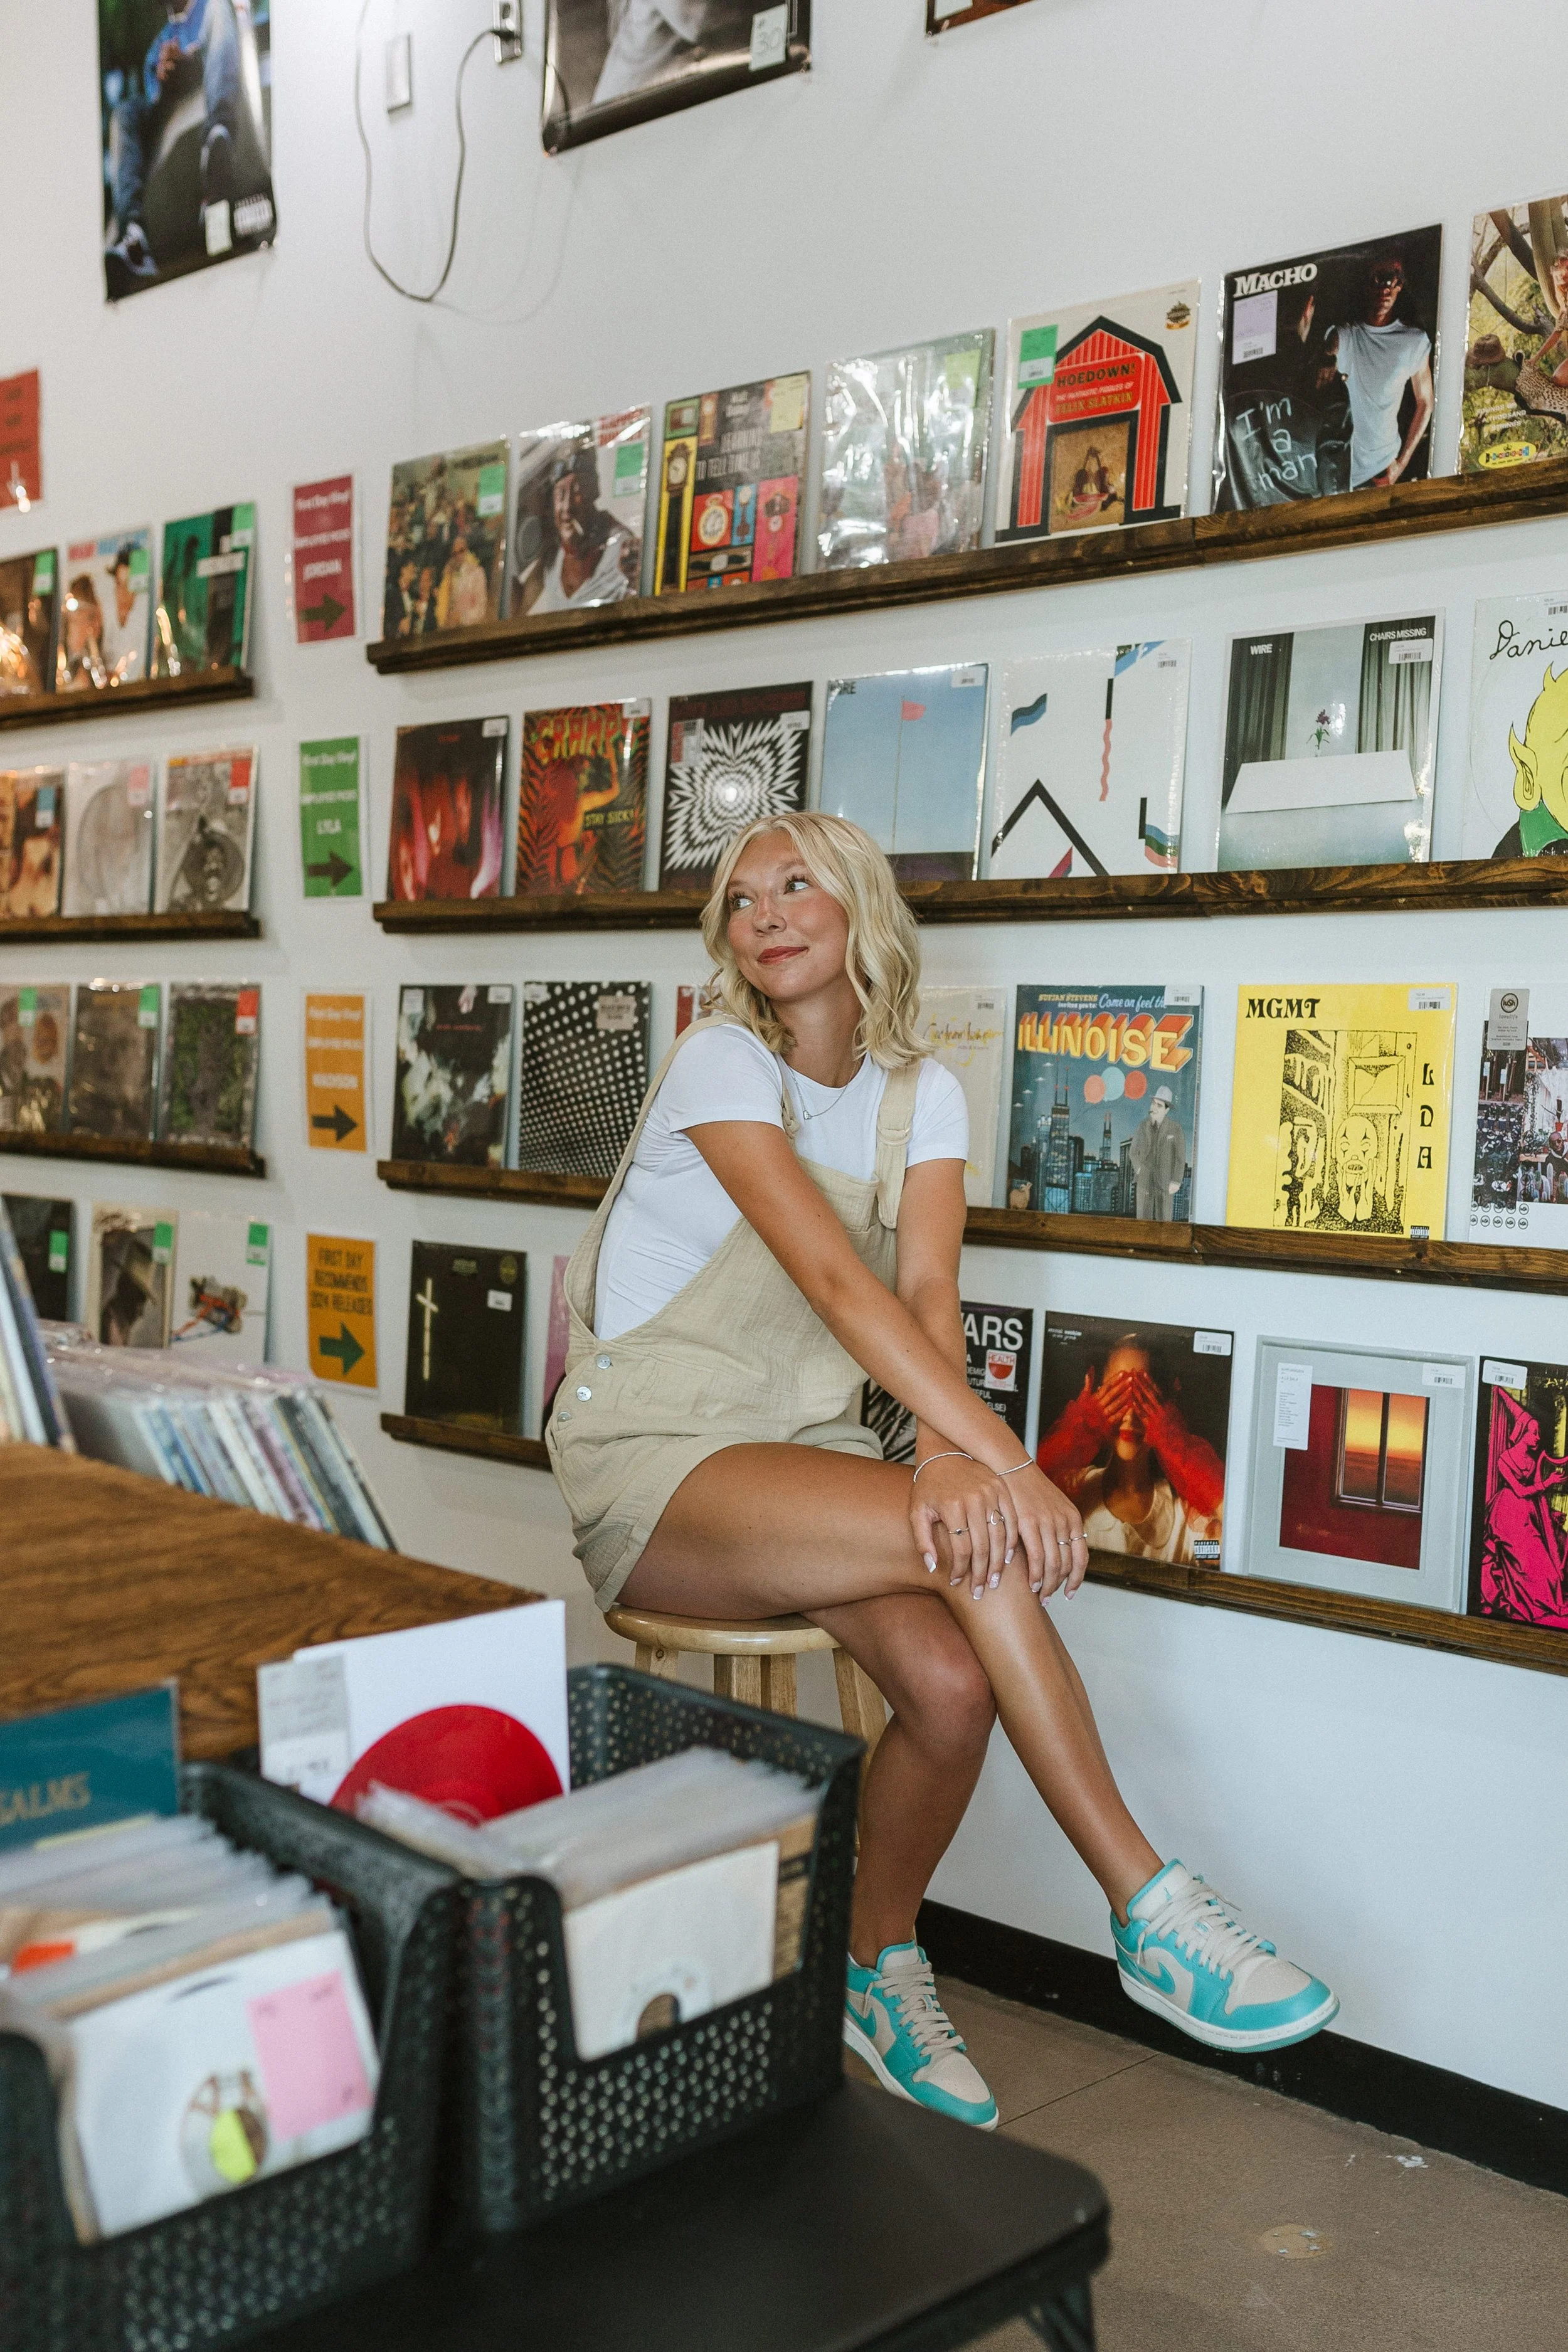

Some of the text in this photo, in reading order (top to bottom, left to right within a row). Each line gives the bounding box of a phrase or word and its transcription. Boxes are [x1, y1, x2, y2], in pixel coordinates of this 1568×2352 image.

[1234, 263, 1317, 298] MACHO
[1057, 363, 1136, 388] HOEDOWN!
[1056, 391, 1133, 415] FELIX SLATKIN
[1236, 397, 1292, 439] I'm
[1273, 428, 1291, 453] a
[1258, 453, 1317, 491] man
[1370, 627, 1427, 642] CHAIRS MISSING
[1490, 620, 1568, 660] Danie
[1251, 644, 1273, 655] WIRE
[1039, 993, 1098, 1002] SUFJAN STEVENS
[1099, 993, 1123, 1009] Come
[1125, 999, 1136, 1009] on
[1135, 995, 1152, 1012] feel
[1246, 997, 1321, 1019] MGMT
[1017, 1011, 1194, 1073] ILLINOISE
[318, 1248, 363, 1269] FIRST DAY
[961, 1313, 1023, 1350] ARS
[967, 1366, 985, 1376] DEMIG
[988, 1353, 1015, 1365] HEALTH
